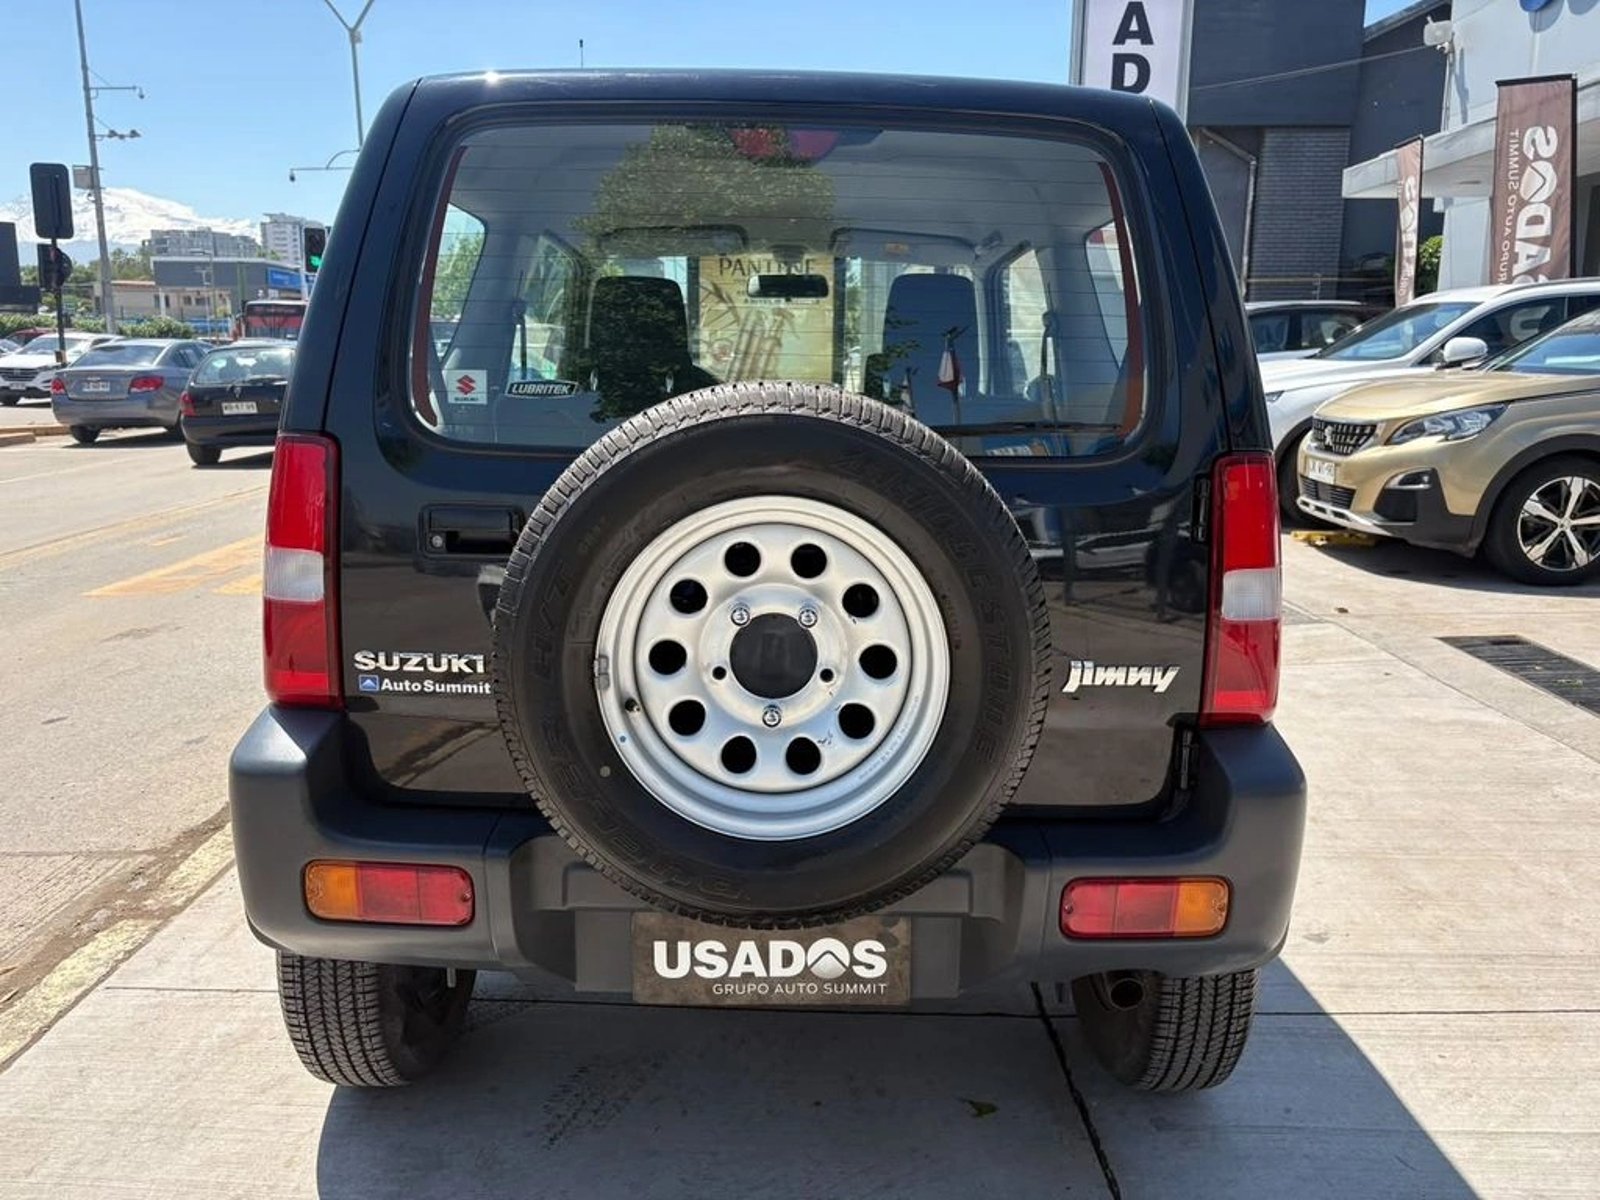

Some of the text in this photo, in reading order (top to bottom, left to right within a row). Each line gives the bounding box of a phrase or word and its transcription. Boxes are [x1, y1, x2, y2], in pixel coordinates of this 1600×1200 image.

[512, 384, 571, 394] LUBRITEK
[354, 650, 485, 673] SUZUKI
[653, 937, 887, 979] USADOS
[713, 983, 887, 995] GRUPO AUTO SUMMIT
